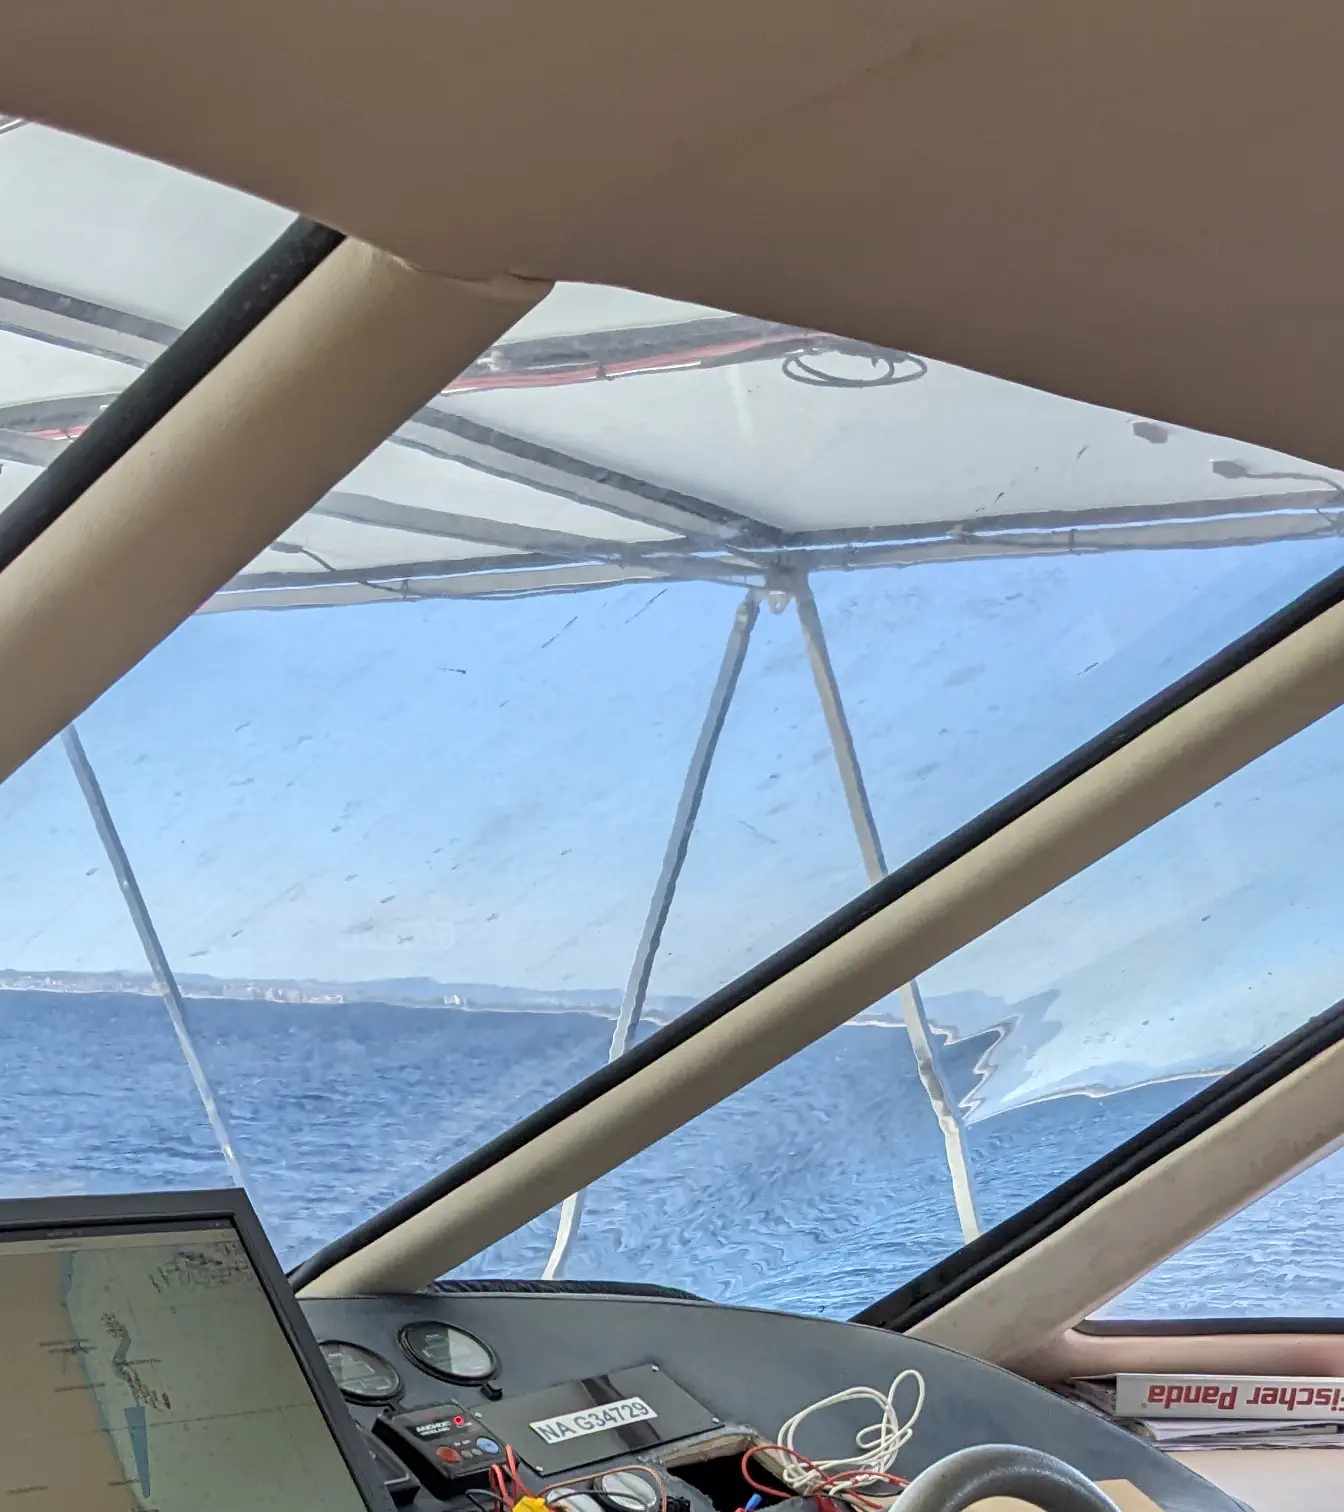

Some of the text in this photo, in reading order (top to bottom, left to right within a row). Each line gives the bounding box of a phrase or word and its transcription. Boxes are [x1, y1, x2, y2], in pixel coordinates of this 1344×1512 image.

[1147, 1384, 1238, 1410] Panda
[536, 1402, 650, 1441] NA G34729
